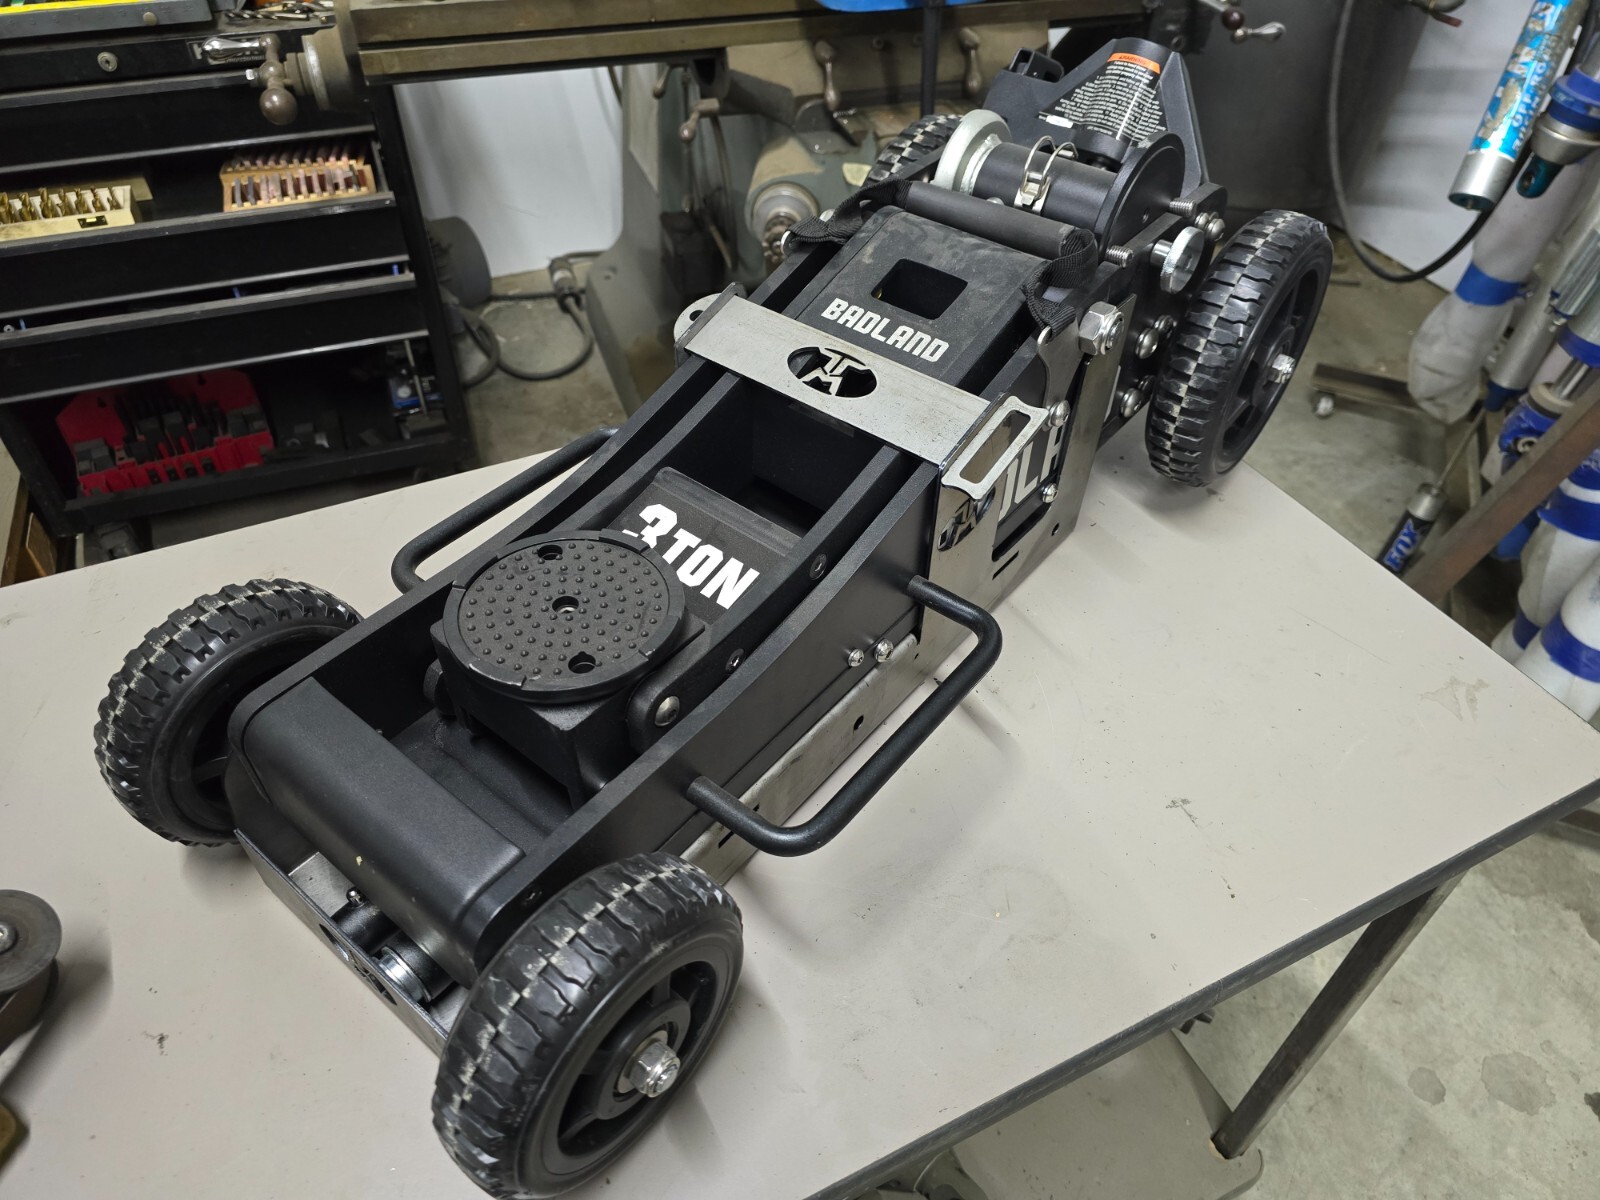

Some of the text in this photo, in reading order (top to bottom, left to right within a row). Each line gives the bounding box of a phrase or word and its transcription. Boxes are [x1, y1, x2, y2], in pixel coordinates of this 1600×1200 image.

[821, 298, 949, 363] BADLAND
[662, 528, 760, 610] TON
[1384, 518, 1419, 572] FOX
